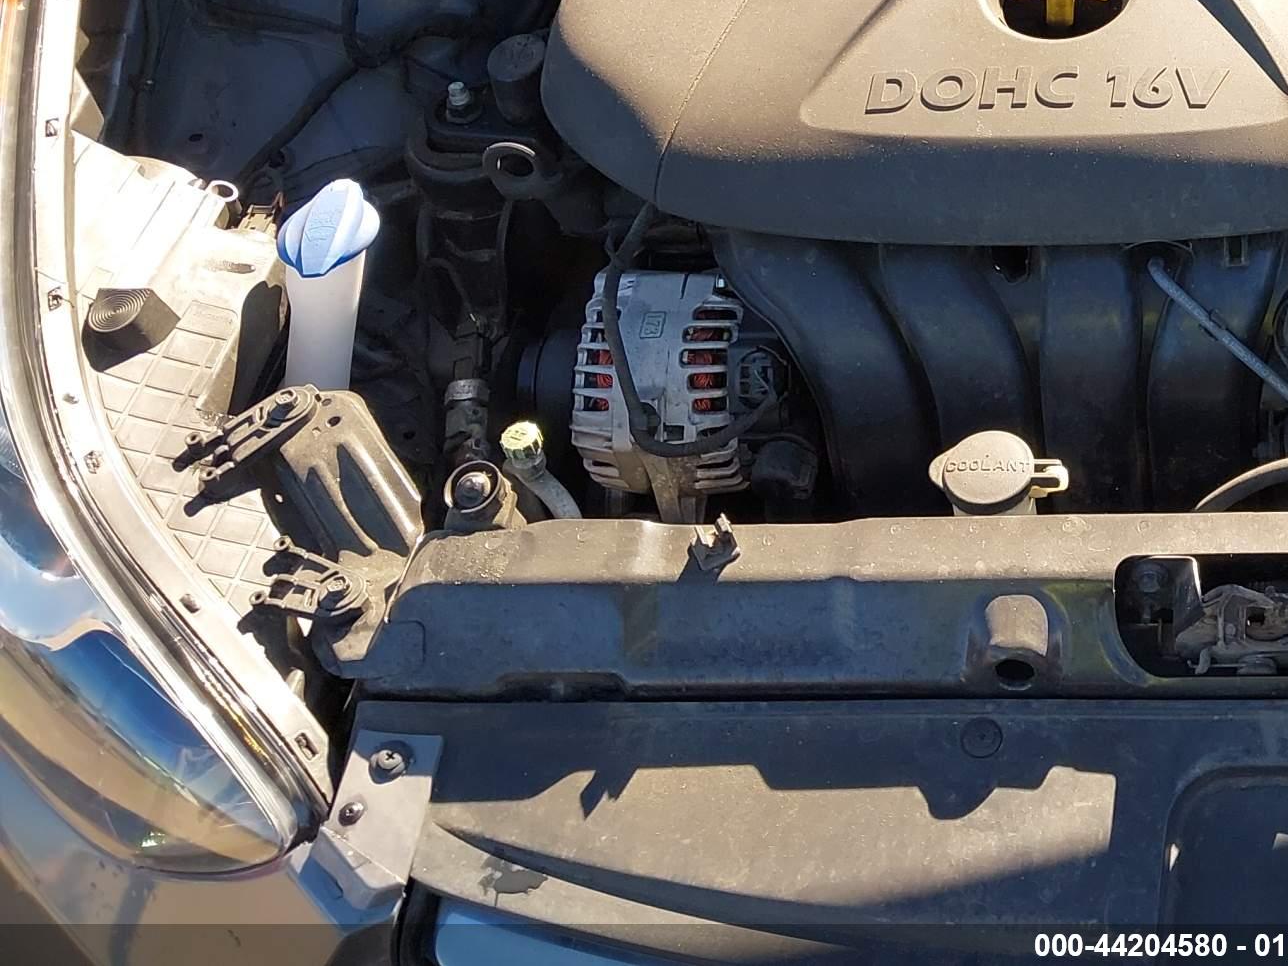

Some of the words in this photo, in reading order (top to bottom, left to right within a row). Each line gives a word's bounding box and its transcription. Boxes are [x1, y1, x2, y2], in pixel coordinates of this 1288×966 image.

[864, 65, 1080, 115] DOHC
[1104, 65, 1231, 110] 16V
[945, 458, 1030, 473] COOLANT
